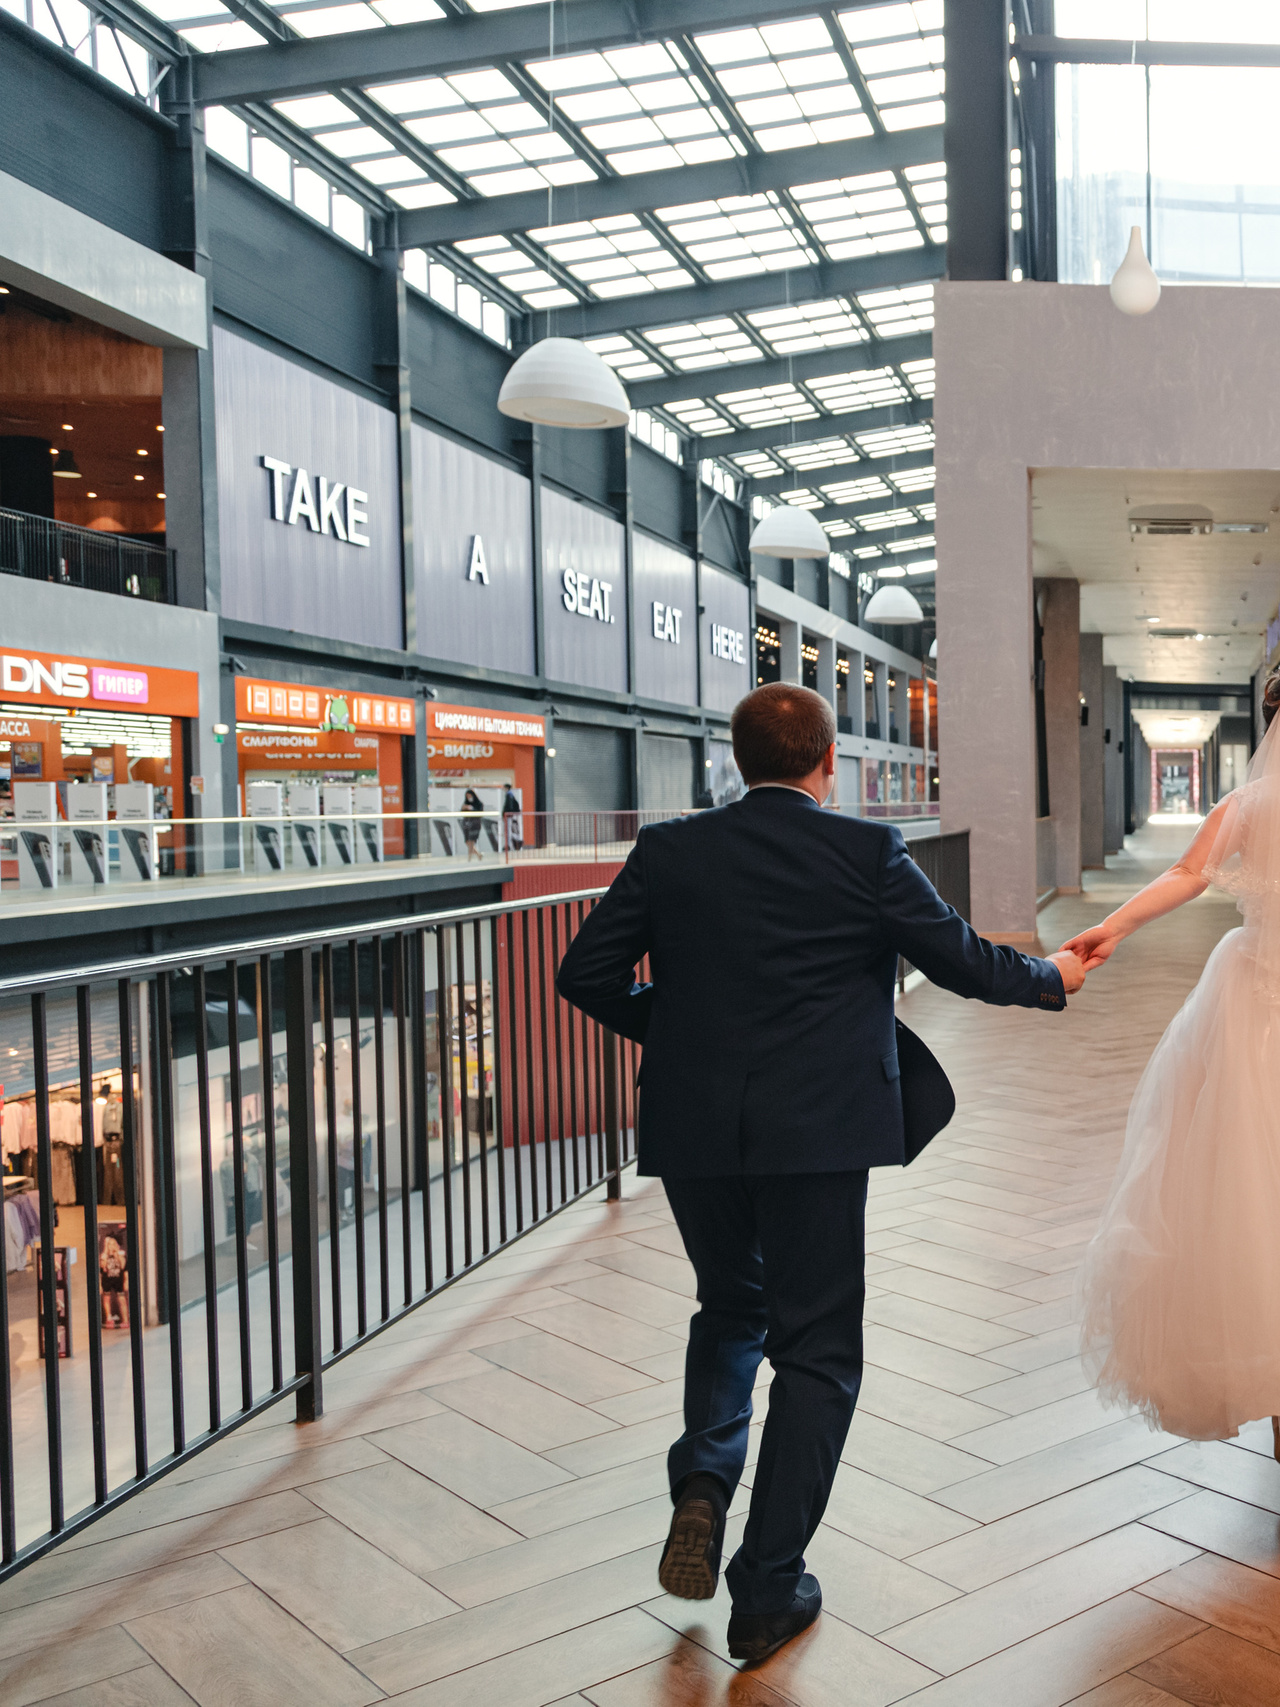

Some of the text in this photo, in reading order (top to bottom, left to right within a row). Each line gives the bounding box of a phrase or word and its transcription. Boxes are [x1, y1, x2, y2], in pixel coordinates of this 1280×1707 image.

[260, 455, 747, 665] TAKE A SEAT. EAT HERE.
[0, 655, 90, 698] DNS
[98, 674, 144, 696] ГИПЕР
[434, 712, 544, 738] ЦИФРОВАЯ И БЫТОВАЯ ТЕХНИКА
[242, 735, 318, 748] СМАРТФОНЫ
